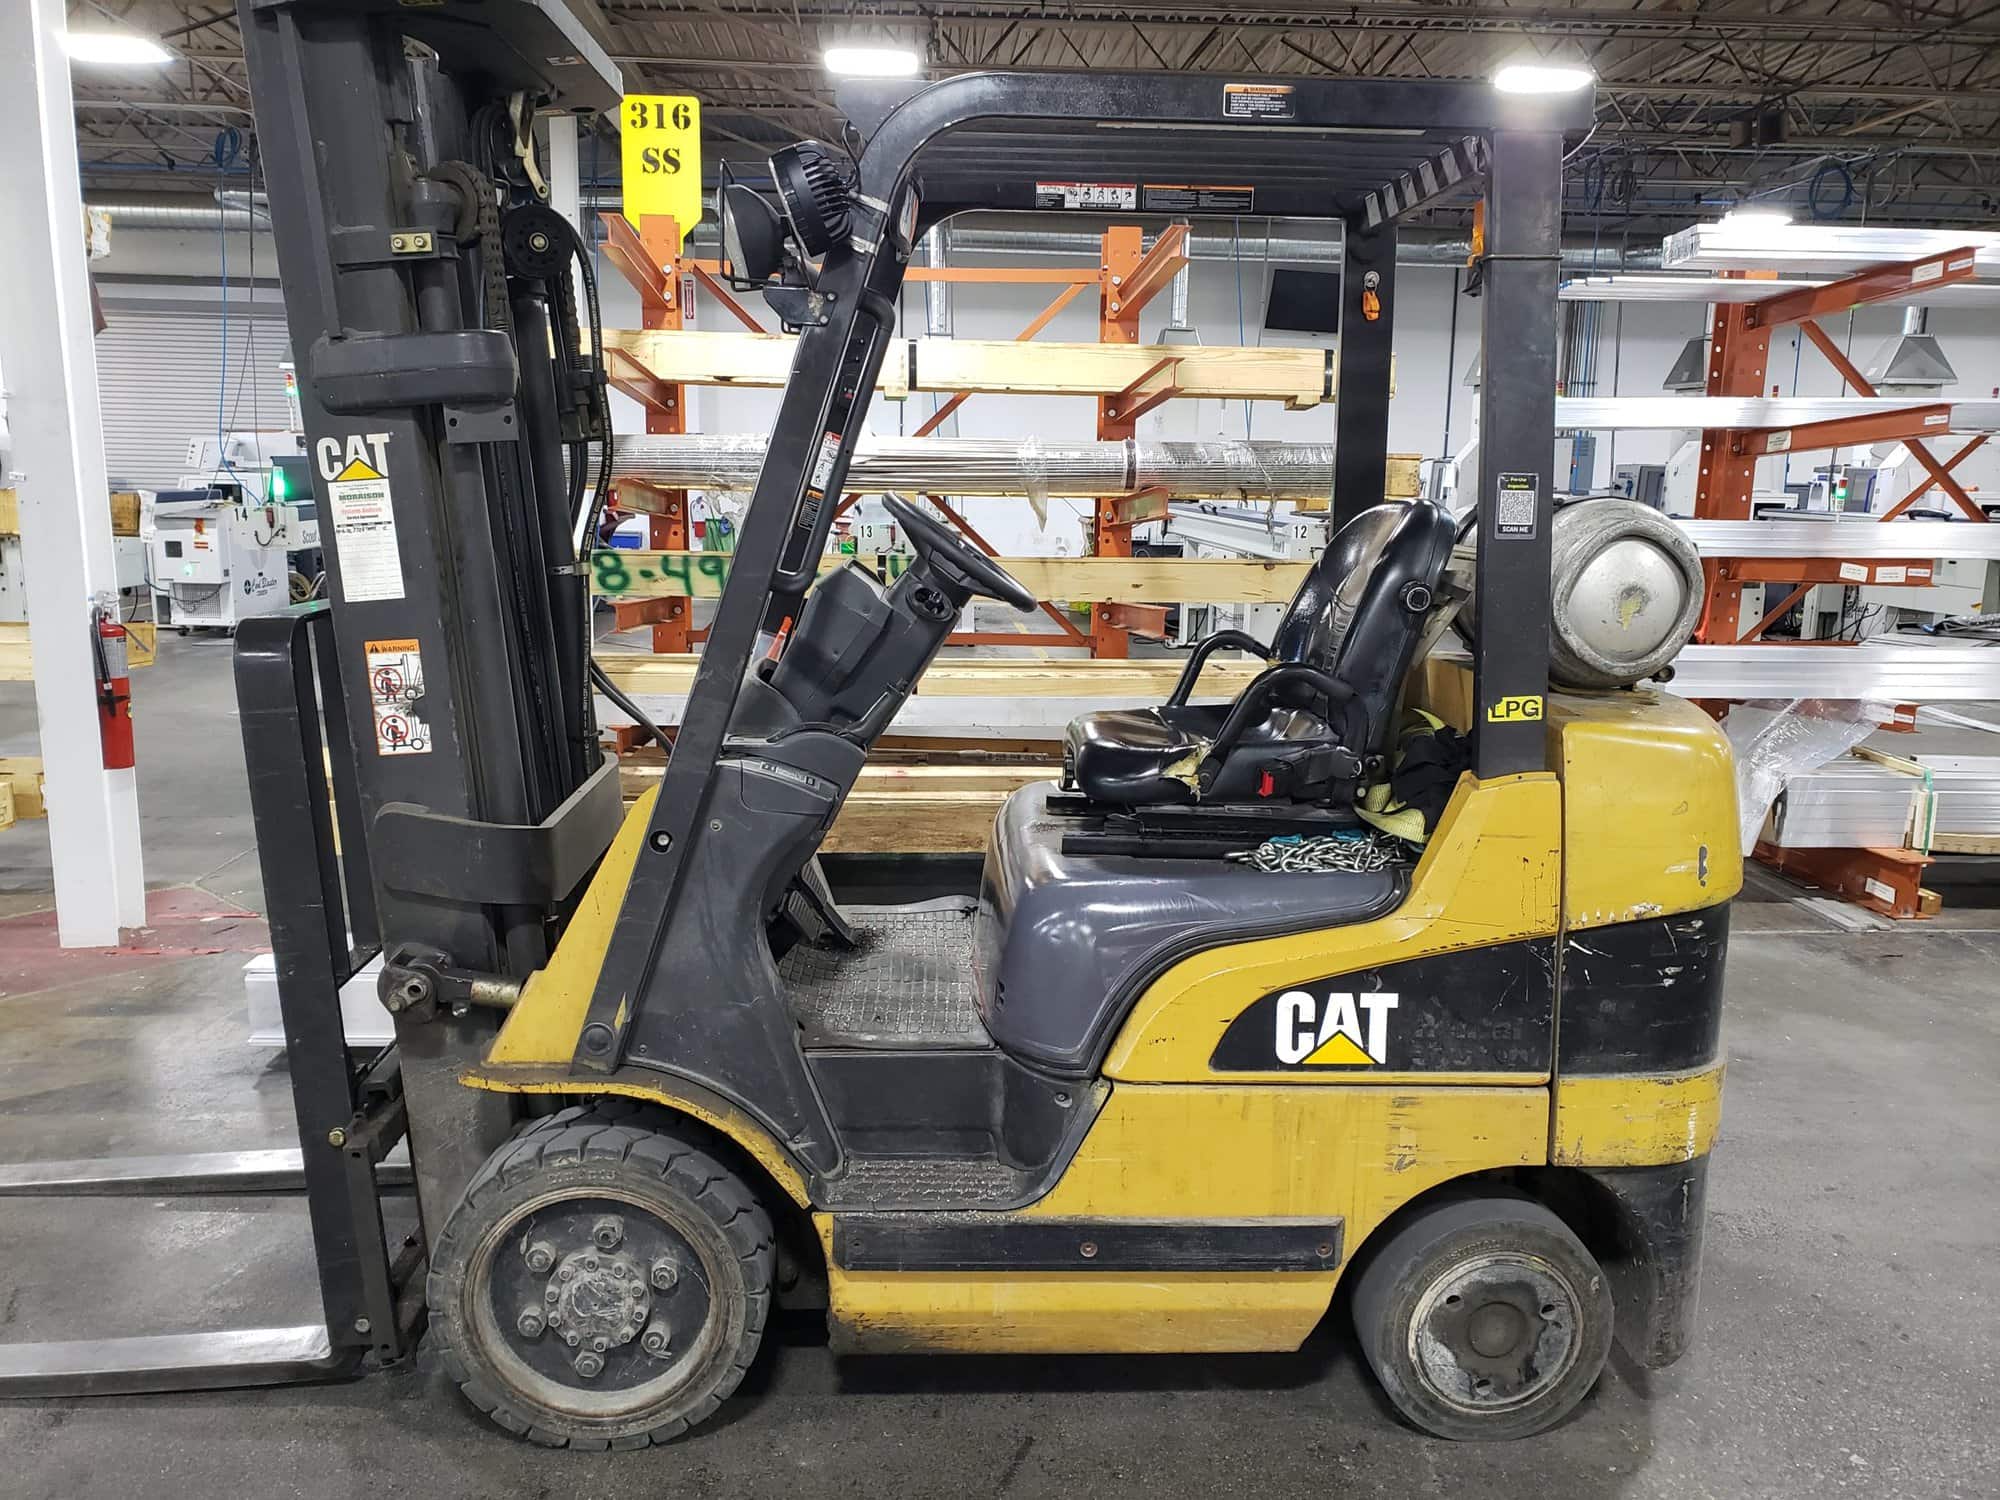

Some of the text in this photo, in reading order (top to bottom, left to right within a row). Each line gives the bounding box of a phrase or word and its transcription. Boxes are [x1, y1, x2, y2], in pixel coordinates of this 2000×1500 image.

[630, 101, 692, 131] 316
[642, 146, 681, 175] SS
[316, 432, 390, 481] CAT
[234, 508, 249, 521] 14
[860, 524, 873, 538] 13
[1294, 525, 1307, 539] 12
[1490, 699, 1540, 718] LPG
[1275, 991, 1399, 1064] CAT
